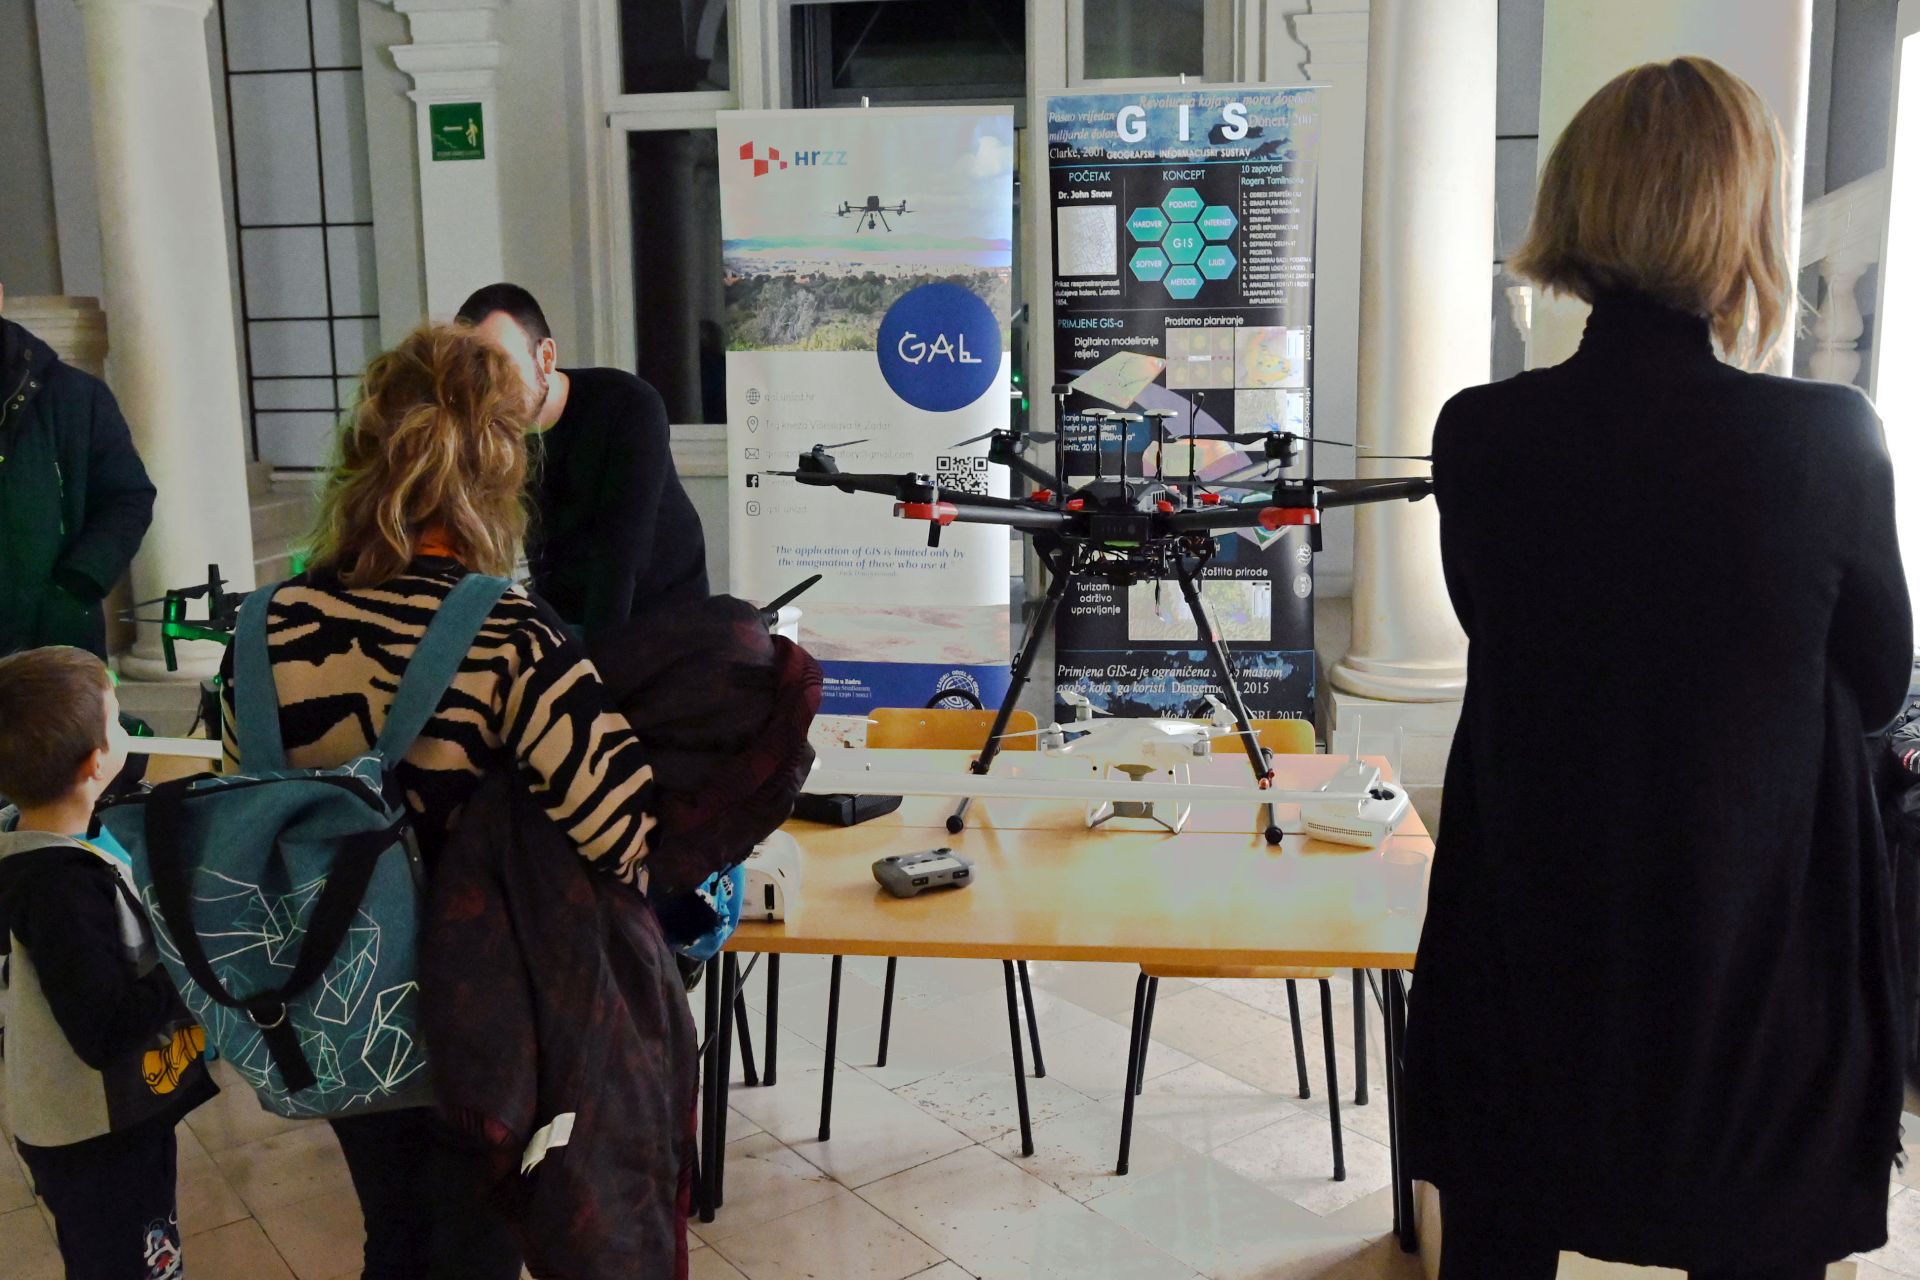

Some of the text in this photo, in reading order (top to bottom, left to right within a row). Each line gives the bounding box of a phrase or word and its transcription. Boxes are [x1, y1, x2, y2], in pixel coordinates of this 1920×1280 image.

[1049, 148, 1081, 160] Clarke,
[1220, 147, 1250, 158] SUSTAV
[1162, 169, 1206, 181] KONCEPT
[1241, 164, 1283, 175] 10 zapovjedi
[1068, 170, 1111, 182] POČETAK
[1058, 189, 1113, 200] Dr. John Snow
[1132, 220, 1162, 229] HARDVER
[1203, 218, 1232, 226] INTERNET
[1136, 260, 1162, 268] SOFTVER
[1099, 288, 1121, 296] London
[1057, 318, 1124, 329] PRIMJENE GIS-a
[1164, 315, 1244, 327] Prostorno planiranje
[1074, 336, 1159, 348] Digitalno modeliranje
[1074, 349, 1100, 360] reljefa
[795, 545, 850, 557] application
[930, 548, 950, 559] only
[953, 548, 966, 559] by
[897, 560, 918, 570] who
[920, 562, 937, 570] use
[1203, 567, 1269, 579] Zaštita prirode
[1076, 582, 1110, 591] Turizam
[1079, 593, 1113, 603] održivo
[1071, 604, 1121, 616] upravljanje
[1057, 664, 1104, 681] Primjena
[1107, 664, 1137, 678] GIS-a
[1137, 665, 1150, 680] je
[1151, 665, 1210, 680] ograničena
[1242, 666, 1283, 678] maštom
[1056, 682, 1087, 694] osobe
[1088, 682, 1112, 696] koja
[1116, 684, 1130, 696] ga
[1132, 681, 1165, 694] koristi
[1243, 681, 1270, 694] 2015
[1275, 710, 1303, 720] 2017
